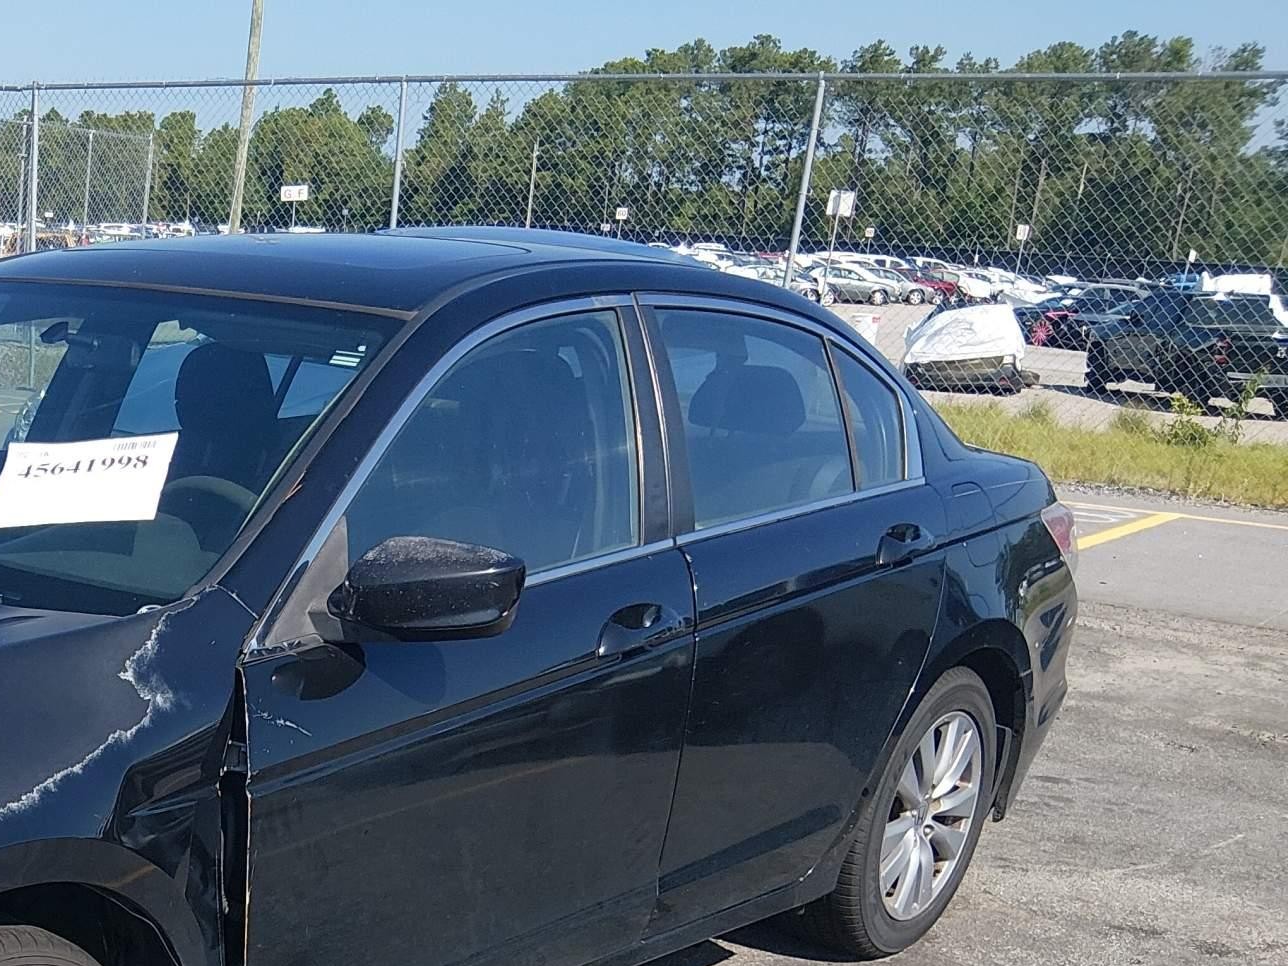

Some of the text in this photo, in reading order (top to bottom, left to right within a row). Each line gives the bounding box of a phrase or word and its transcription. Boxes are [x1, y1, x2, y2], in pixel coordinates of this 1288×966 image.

[284, 188, 305, 199] G F
[18, 455, 149, 478] 45641998
